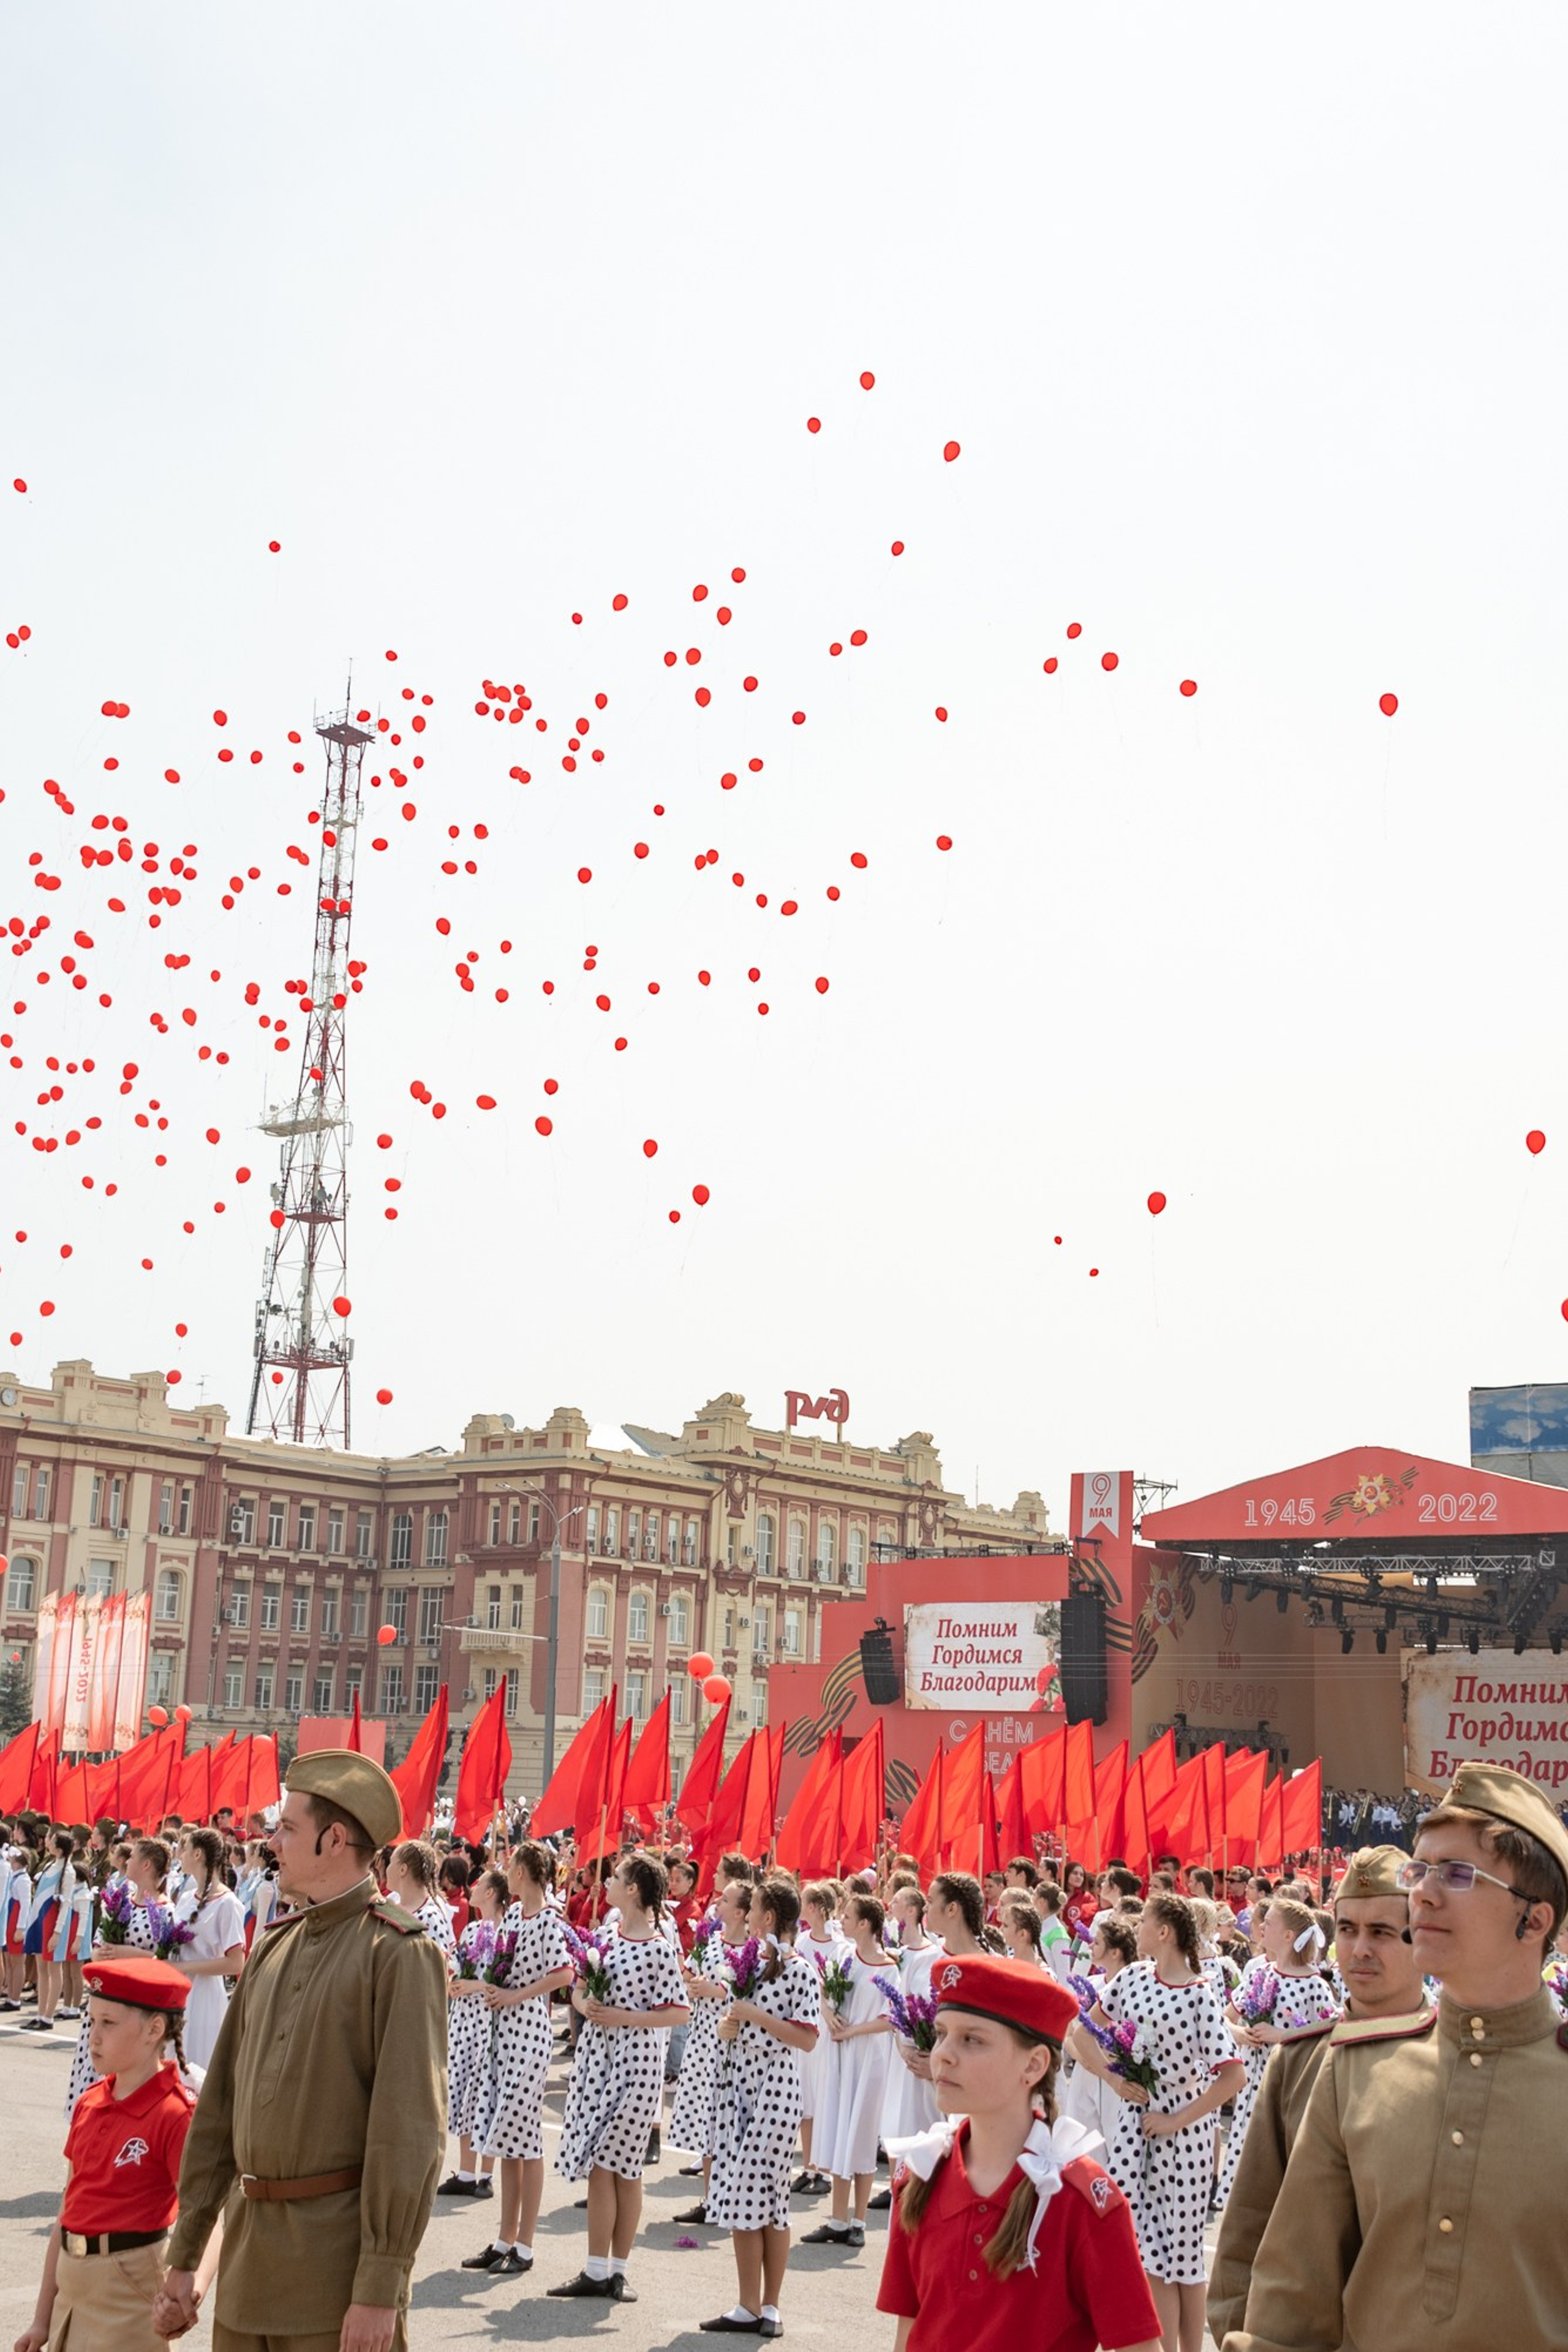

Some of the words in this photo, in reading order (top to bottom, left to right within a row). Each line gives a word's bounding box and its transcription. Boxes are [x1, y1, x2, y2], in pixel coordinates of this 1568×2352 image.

[1091, 1474, 1111, 1505] 9
[1089, 1507, 1112, 1518] МАЯ
[1244, 1498, 1316, 1526] 1945
[1418, 1493, 1498, 1523] 2022
[937, 1619, 1017, 1638] Помним
[932, 1643, 1022, 1669] Гордимся
[920, 1671, 1036, 1696] Благодарим
[1175, 1679, 1278, 1719] 1945-2022
[949, 1720, 967, 1742] С
[984, 1717, 1034, 1743] НЁМ
